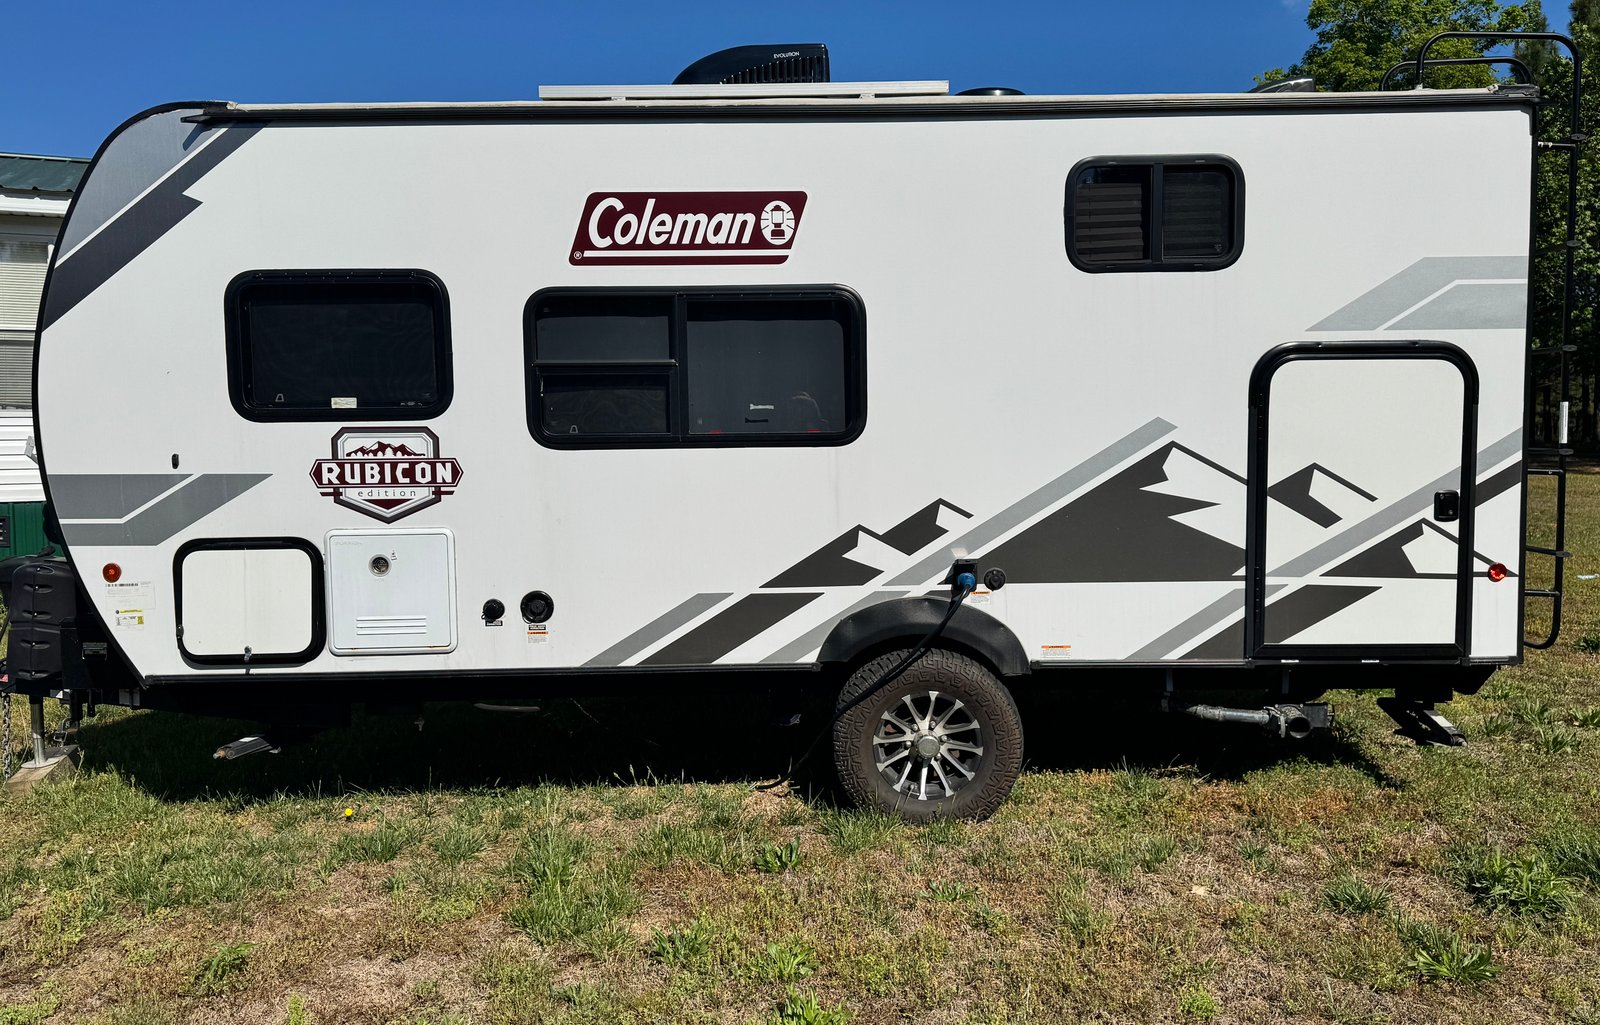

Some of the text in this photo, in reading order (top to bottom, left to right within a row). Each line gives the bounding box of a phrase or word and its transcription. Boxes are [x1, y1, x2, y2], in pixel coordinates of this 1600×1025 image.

[773, 51, 800, 59] EVOLUTION
[588, 197, 756, 248] Coleman
[321, 462, 453, 484] RUBICON
[357, 489, 416, 497] edition
